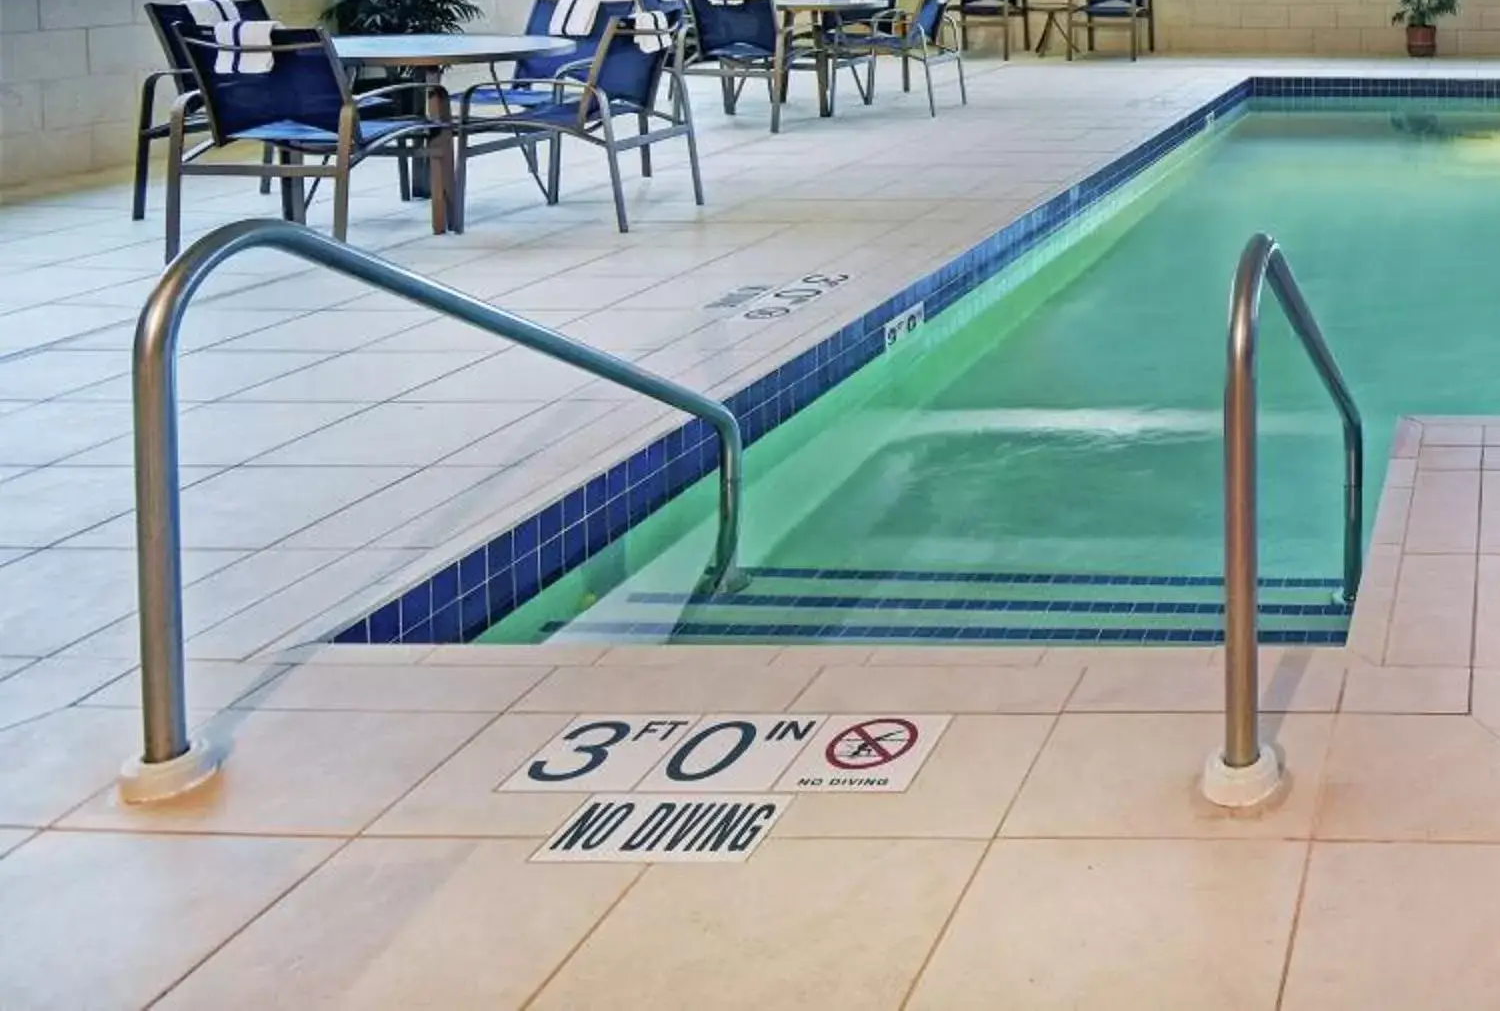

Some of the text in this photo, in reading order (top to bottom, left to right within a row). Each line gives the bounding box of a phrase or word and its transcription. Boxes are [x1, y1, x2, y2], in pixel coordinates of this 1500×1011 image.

[526, 720, 816, 782] 3 FT 0 IN
[798, 777, 889, 786] NO DIVING
[549, 802, 776, 853] NO DIVING
